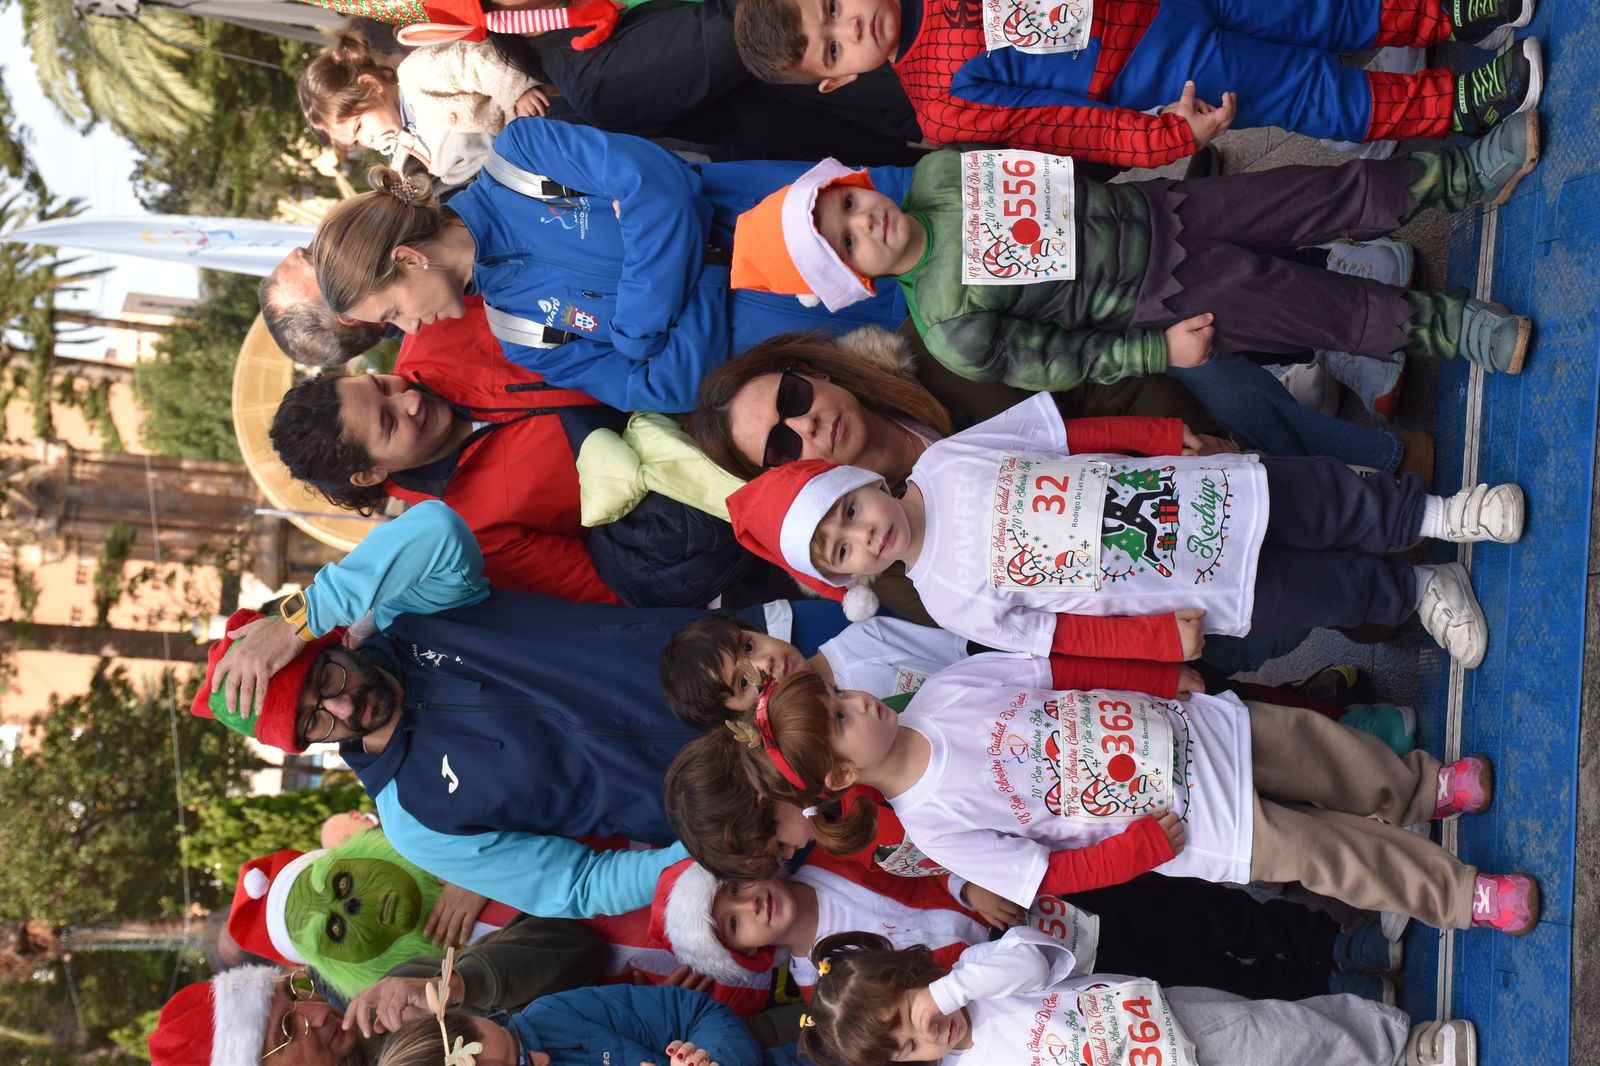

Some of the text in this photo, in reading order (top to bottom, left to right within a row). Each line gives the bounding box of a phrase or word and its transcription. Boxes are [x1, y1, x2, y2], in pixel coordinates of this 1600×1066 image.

[965, 153, 980, 170] Ceuta
[982, 153, 996, 168] Baby
[967, 172, 980, 184] De
[983, 170, 995, 194] Silvestre
[1002, 160, 1036, 217] 556
[967, 185, 981, 210] Ciudad
[985, 196, 994, 208] San
[967, 213, 981, 245] Silvestre
[968, 248, 981, 263] San
[999, 474, 1013, 485] De
[1015, 474, 1028, 497] Silvestre
[995, 485, 1010, 515] Ciudad
[1032, 475, 1069, 515] 32
[1075, 491, 1082, 500] De
[1012, 500, 1023, 514] San
[1072, 501, 1081, 528] Rodrigo
[1187, 475, 1223, 559] Rodrigo
[993, 518, 1006, 552] Silvestre
[992, 555, 1006, 572] San
[897, 672, 913, 694] Ceuta
[1010, 692, 1026, 709] Ceuta
[999, 709, 1017, 720] De
[1029, 709, 1043, 726] Baby
[1079, 706, 1093, 728] Silvestre
[1064, 719, 1078, 746] Ciudad
[1081, 730, 1094, 743] San
[1098, 700, 1135, 754] 363
[987, 721, 1007, 756] Ciudad
[1030, 729, 1043, 762] Silvestre
[991, 759, 1015, 793] Silvestre
[1031, 766, 1043, 783] San
[1065, 748, 1079, 783] Silvestre
[1010, 794, 1026, 810] San
[1065, 787, 1079, 803] San
[1101, 994, 1115, 1013] Baby
[1035, 1009, 1052, 1023] De
[1165, 1017, 1171, 1026] De
[1026, 1020, 1045, 1052] Ciudad
[1064, 1010, 1079, 1066] Silvestre Baby
[1087, 995, 1111, 1066] Ciudad De Ceuta
[1109, 1016, 1121, 1044] Silvestre
[1122, 996, 1162, 1066] 364
[1168, 1028, 1176, 1046] Peña
